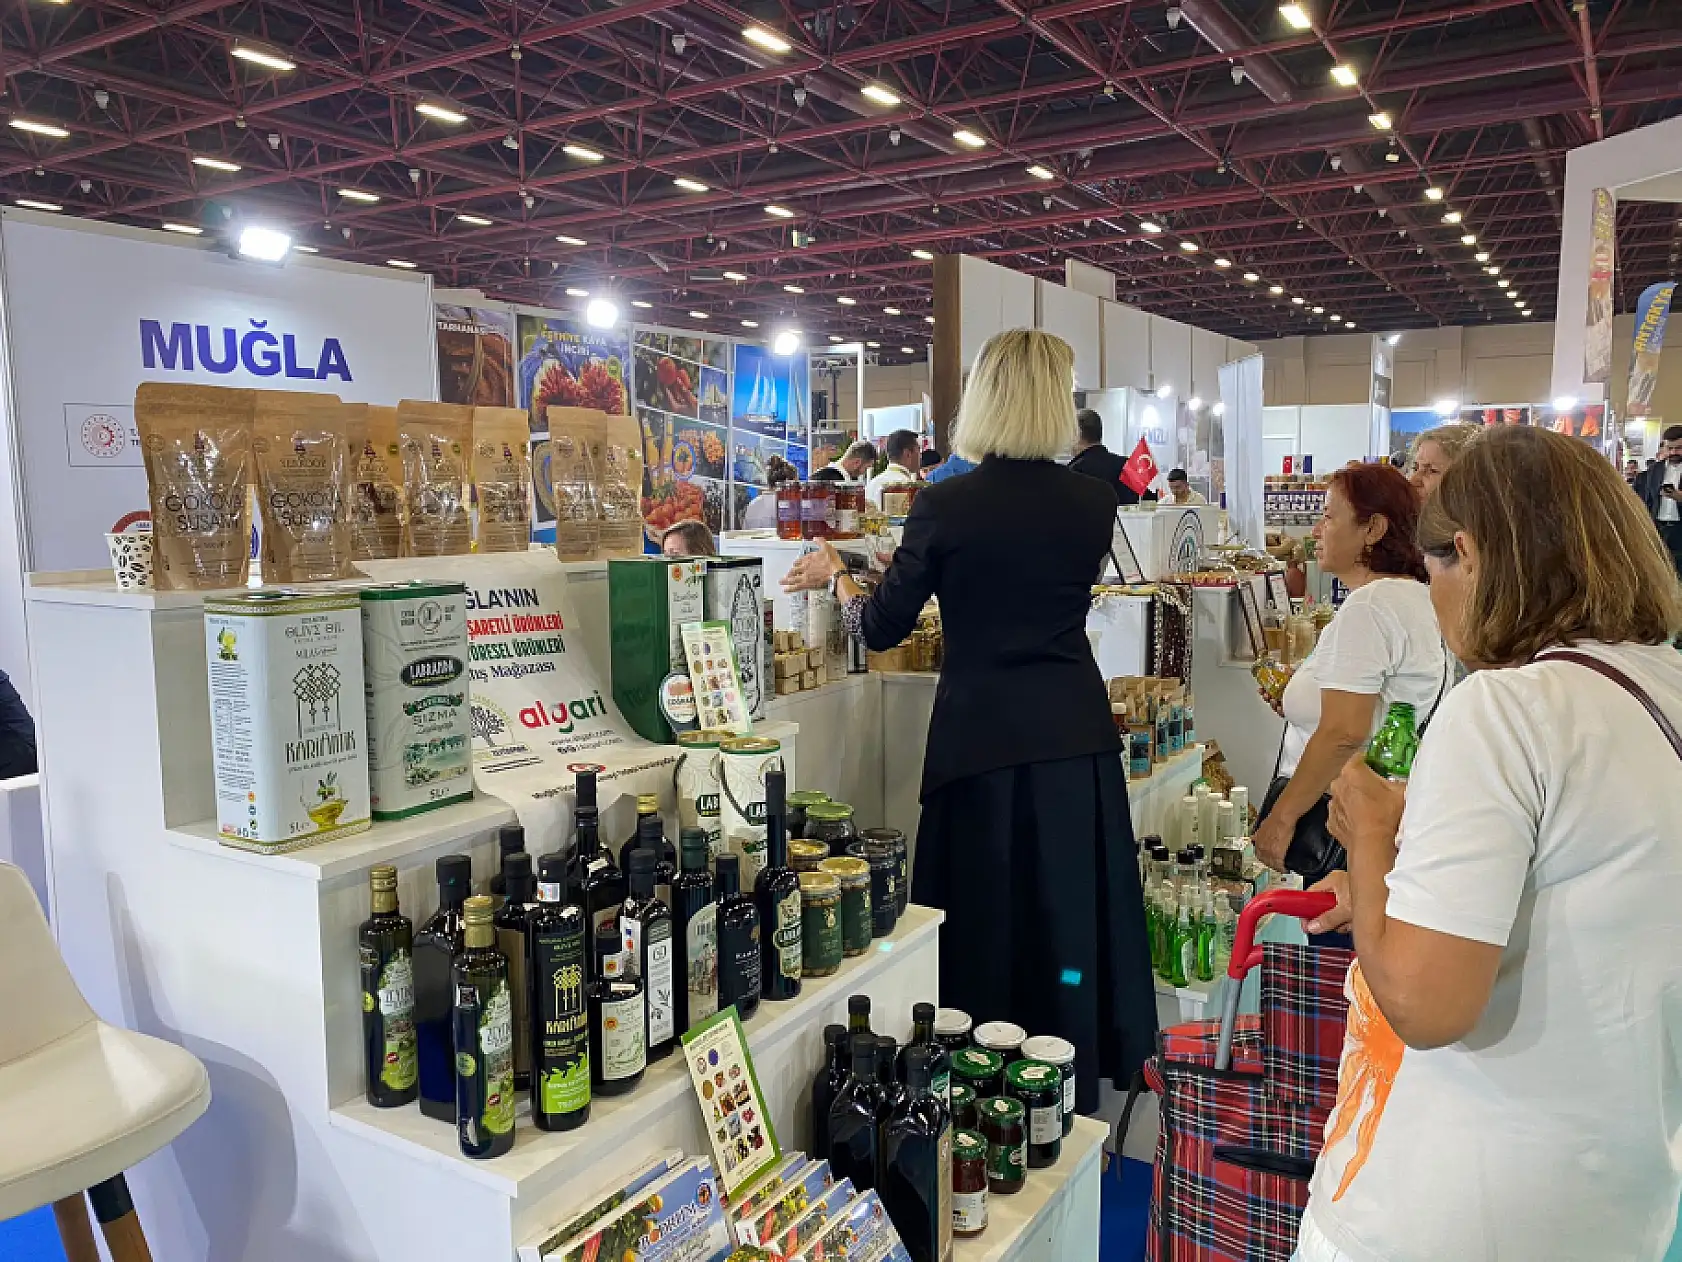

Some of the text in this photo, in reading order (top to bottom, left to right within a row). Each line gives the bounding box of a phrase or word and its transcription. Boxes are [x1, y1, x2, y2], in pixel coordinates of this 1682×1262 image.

[139, 316, 354, 382] MUĞLA
[513, 610, 564, 634] ÜRÜNLERİ
[513, 634, 566, 657] ÜRÜNLERİ
[409, 659, 455, 678] LABRANDA
[491, 660, 557, 680] Mağazası
[412, 708, 458, 727] SIZMA
[518, 690, 608, 734] algari
